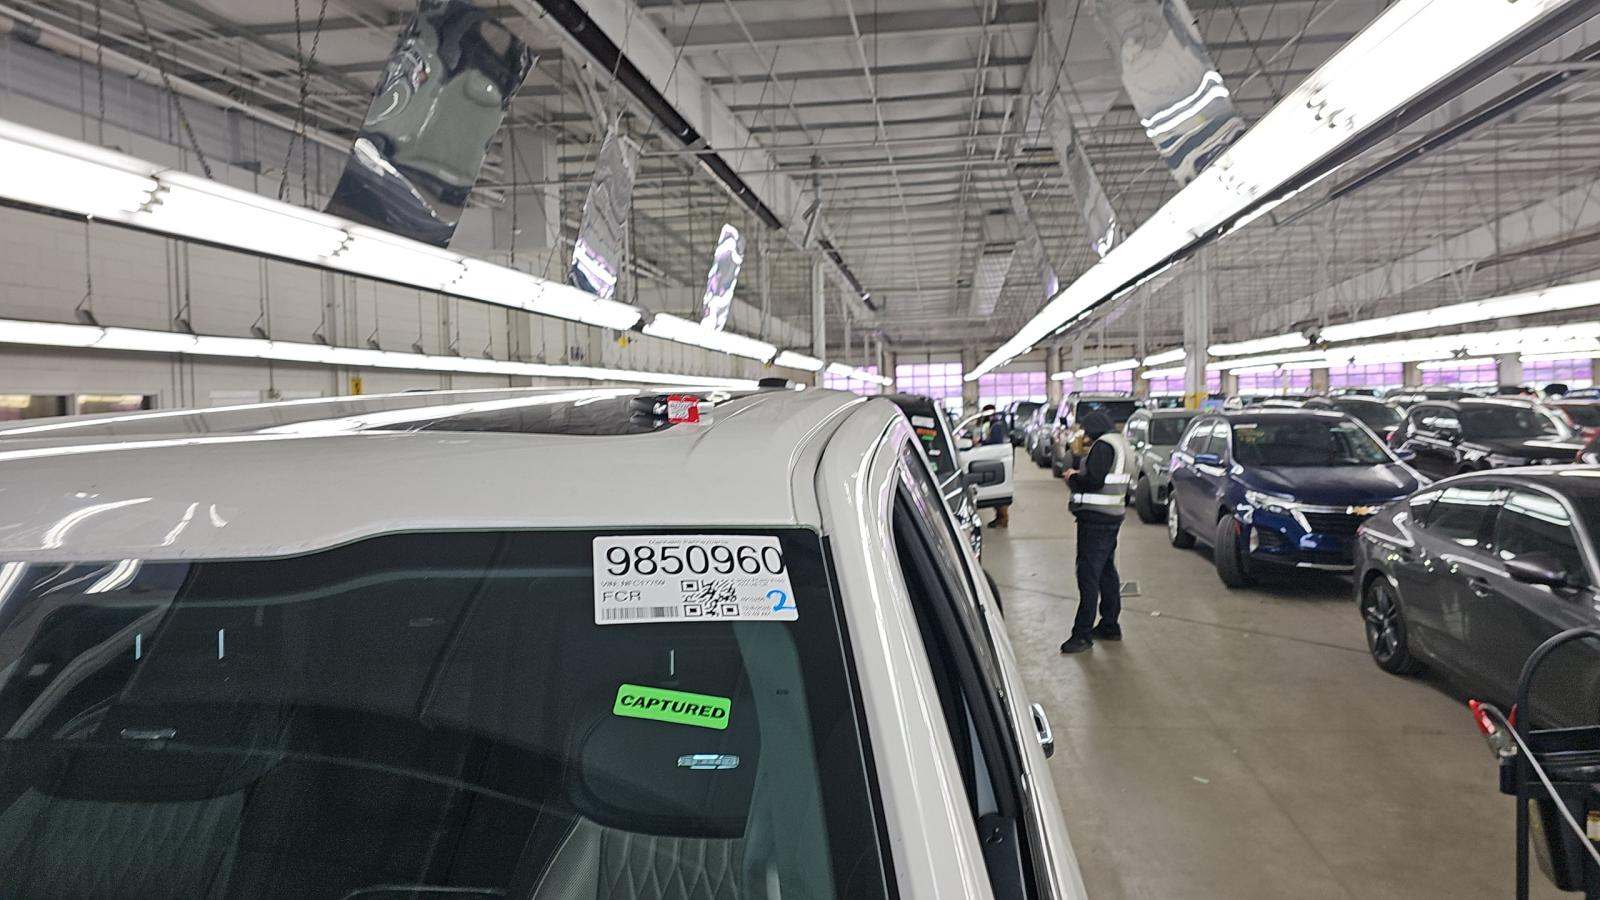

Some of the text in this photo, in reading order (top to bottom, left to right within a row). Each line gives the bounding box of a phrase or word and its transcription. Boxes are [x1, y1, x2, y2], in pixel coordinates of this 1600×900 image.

[606, 545, 783, 576] 9850960
[602, 590, 641, 602] FCR
[766, 589, 796, 612] 2
[620, 694, 726, 719] CAPTURED
